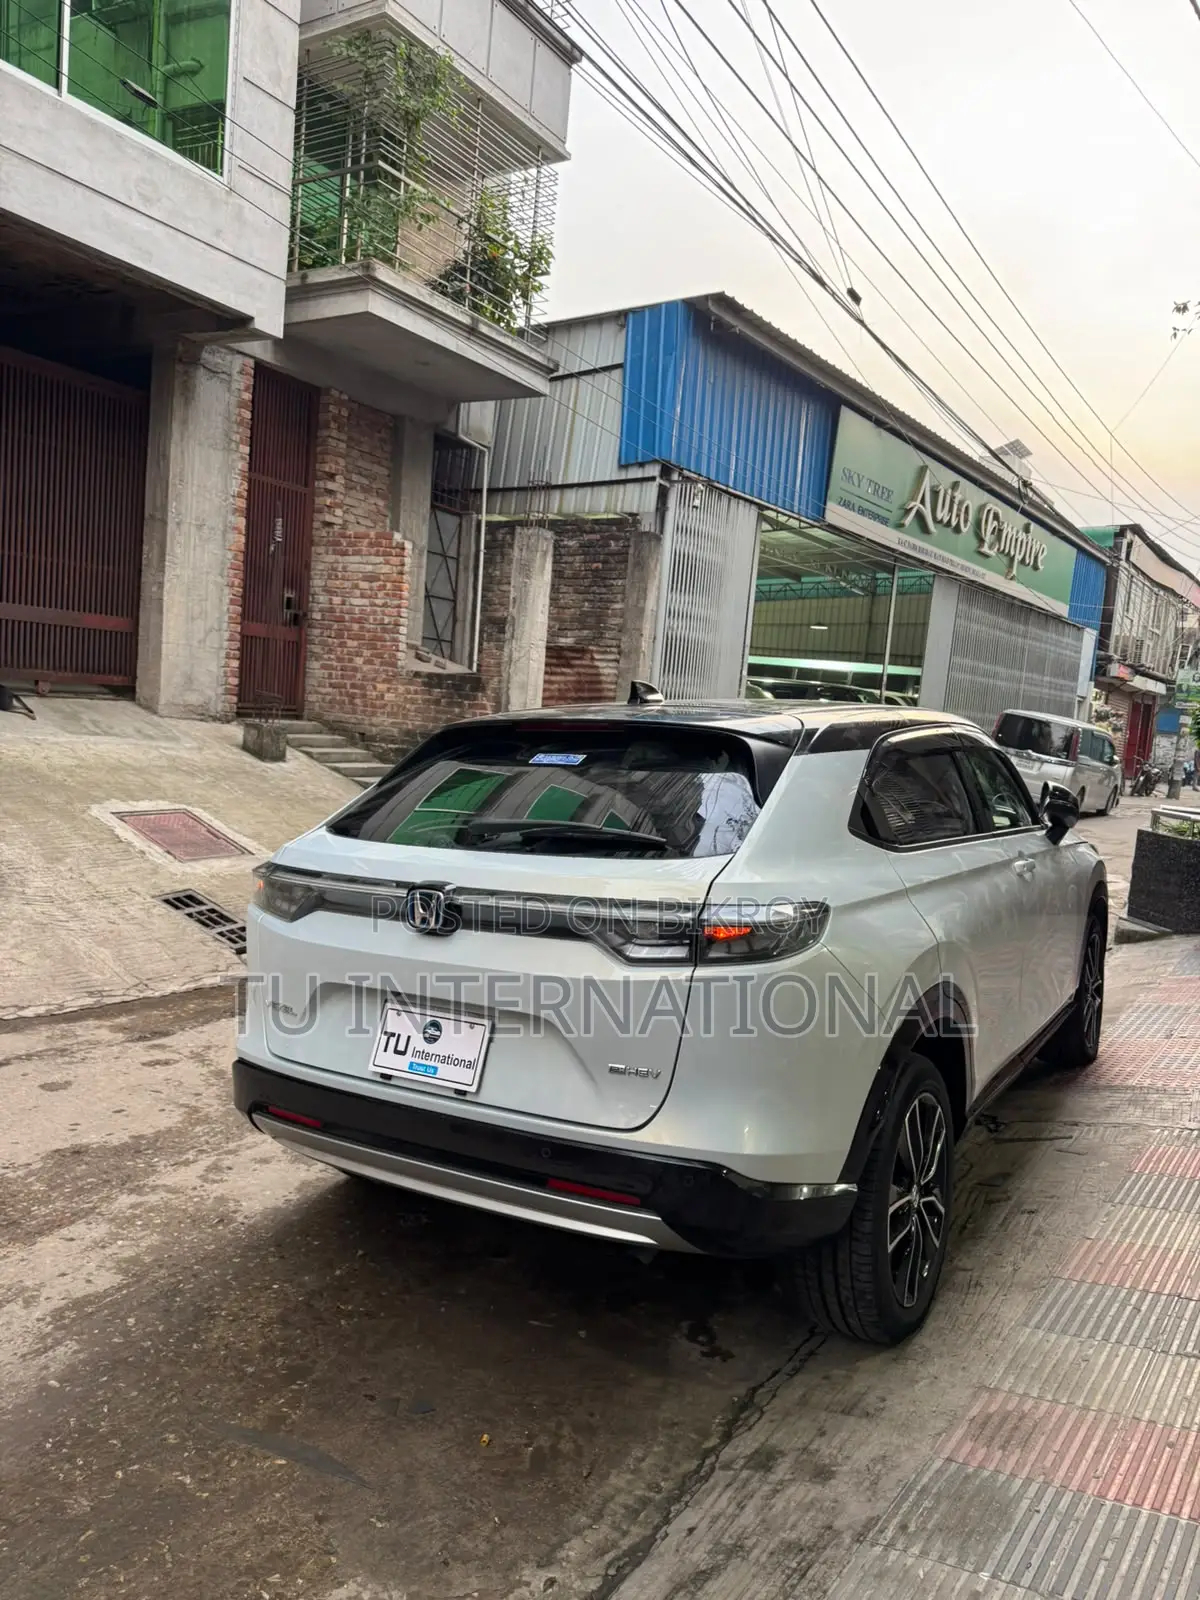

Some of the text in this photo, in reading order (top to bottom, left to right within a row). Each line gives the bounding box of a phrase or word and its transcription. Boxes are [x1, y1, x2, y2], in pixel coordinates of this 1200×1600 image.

[841, 467, 894, 504] SKY TREE
[902, 465, 973, 534] Auto
[978, 503, 1048, 579] Empire
[383, 1030, 477, 1070] TU International
[412, 1063, 436, 1074] Trust Us
